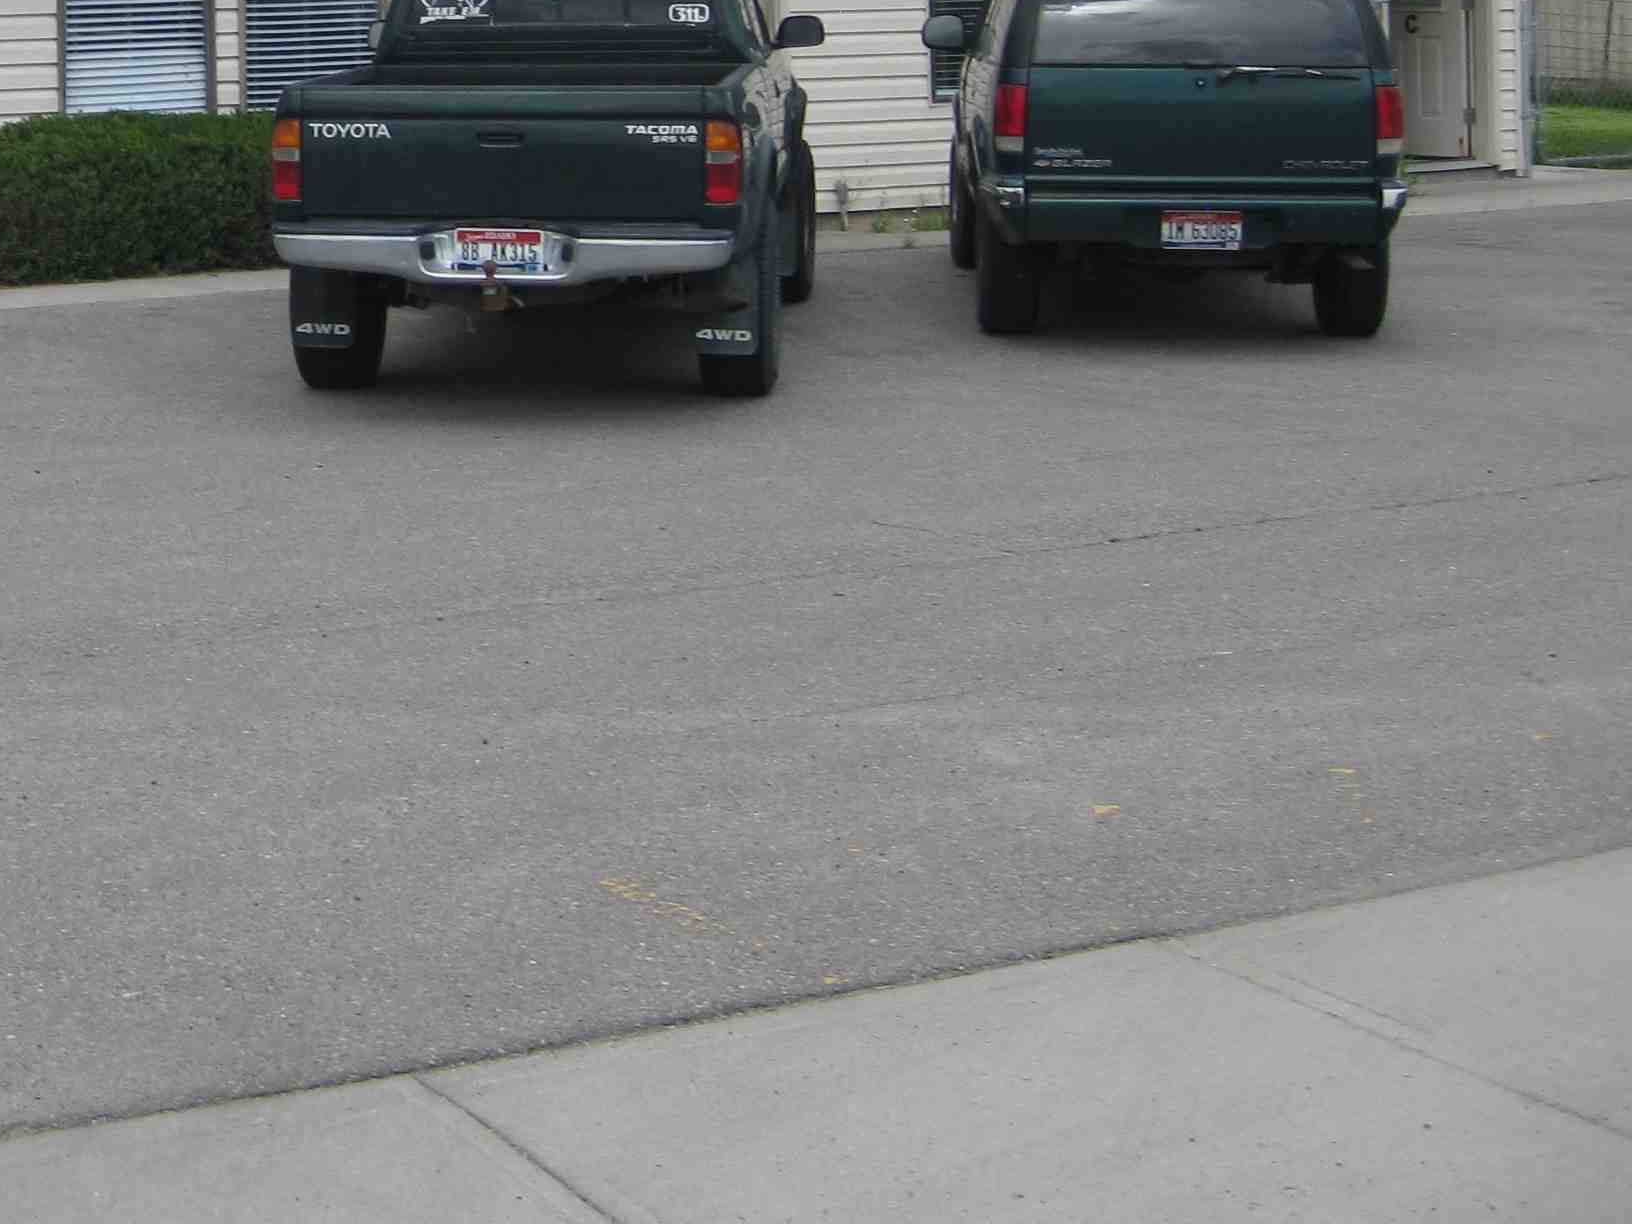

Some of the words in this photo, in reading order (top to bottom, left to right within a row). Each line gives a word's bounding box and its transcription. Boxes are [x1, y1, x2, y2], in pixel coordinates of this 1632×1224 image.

[1404, 14, 1420, 34] C
[308, 123, 391, 138] TOYOTA
[624, 125, 698, 135] TACOMA
[295, 322, 351, 336] 4WD
[695, 328, 753, 342] 4WD
